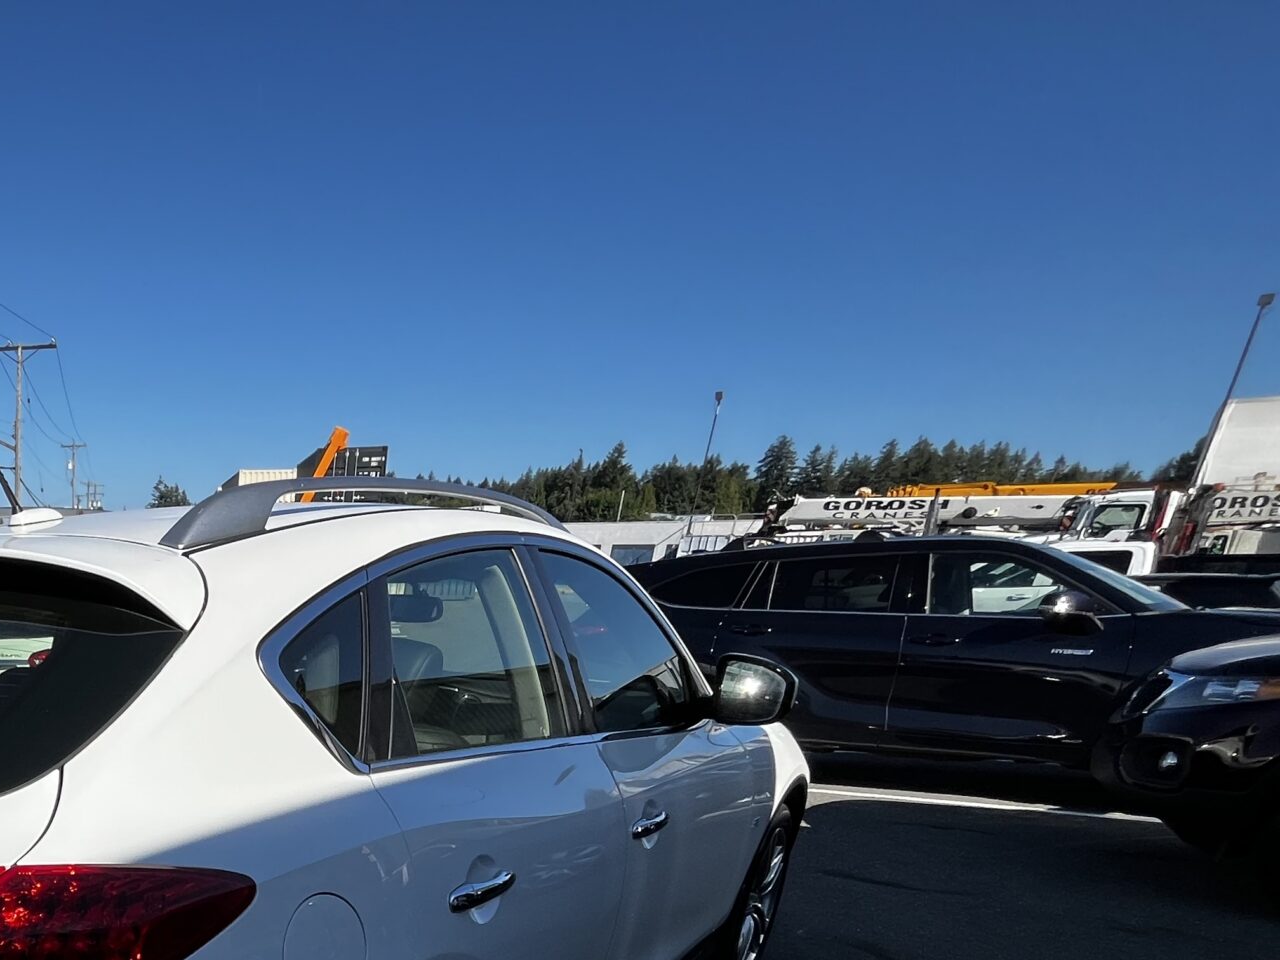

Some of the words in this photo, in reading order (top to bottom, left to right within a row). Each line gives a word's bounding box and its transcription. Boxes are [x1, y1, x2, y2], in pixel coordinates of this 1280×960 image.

[823, 499, 950, 511] GOROSH
[832, 511, 928, 519] CRANES
[1214, 508, 1280, 519] RANE
